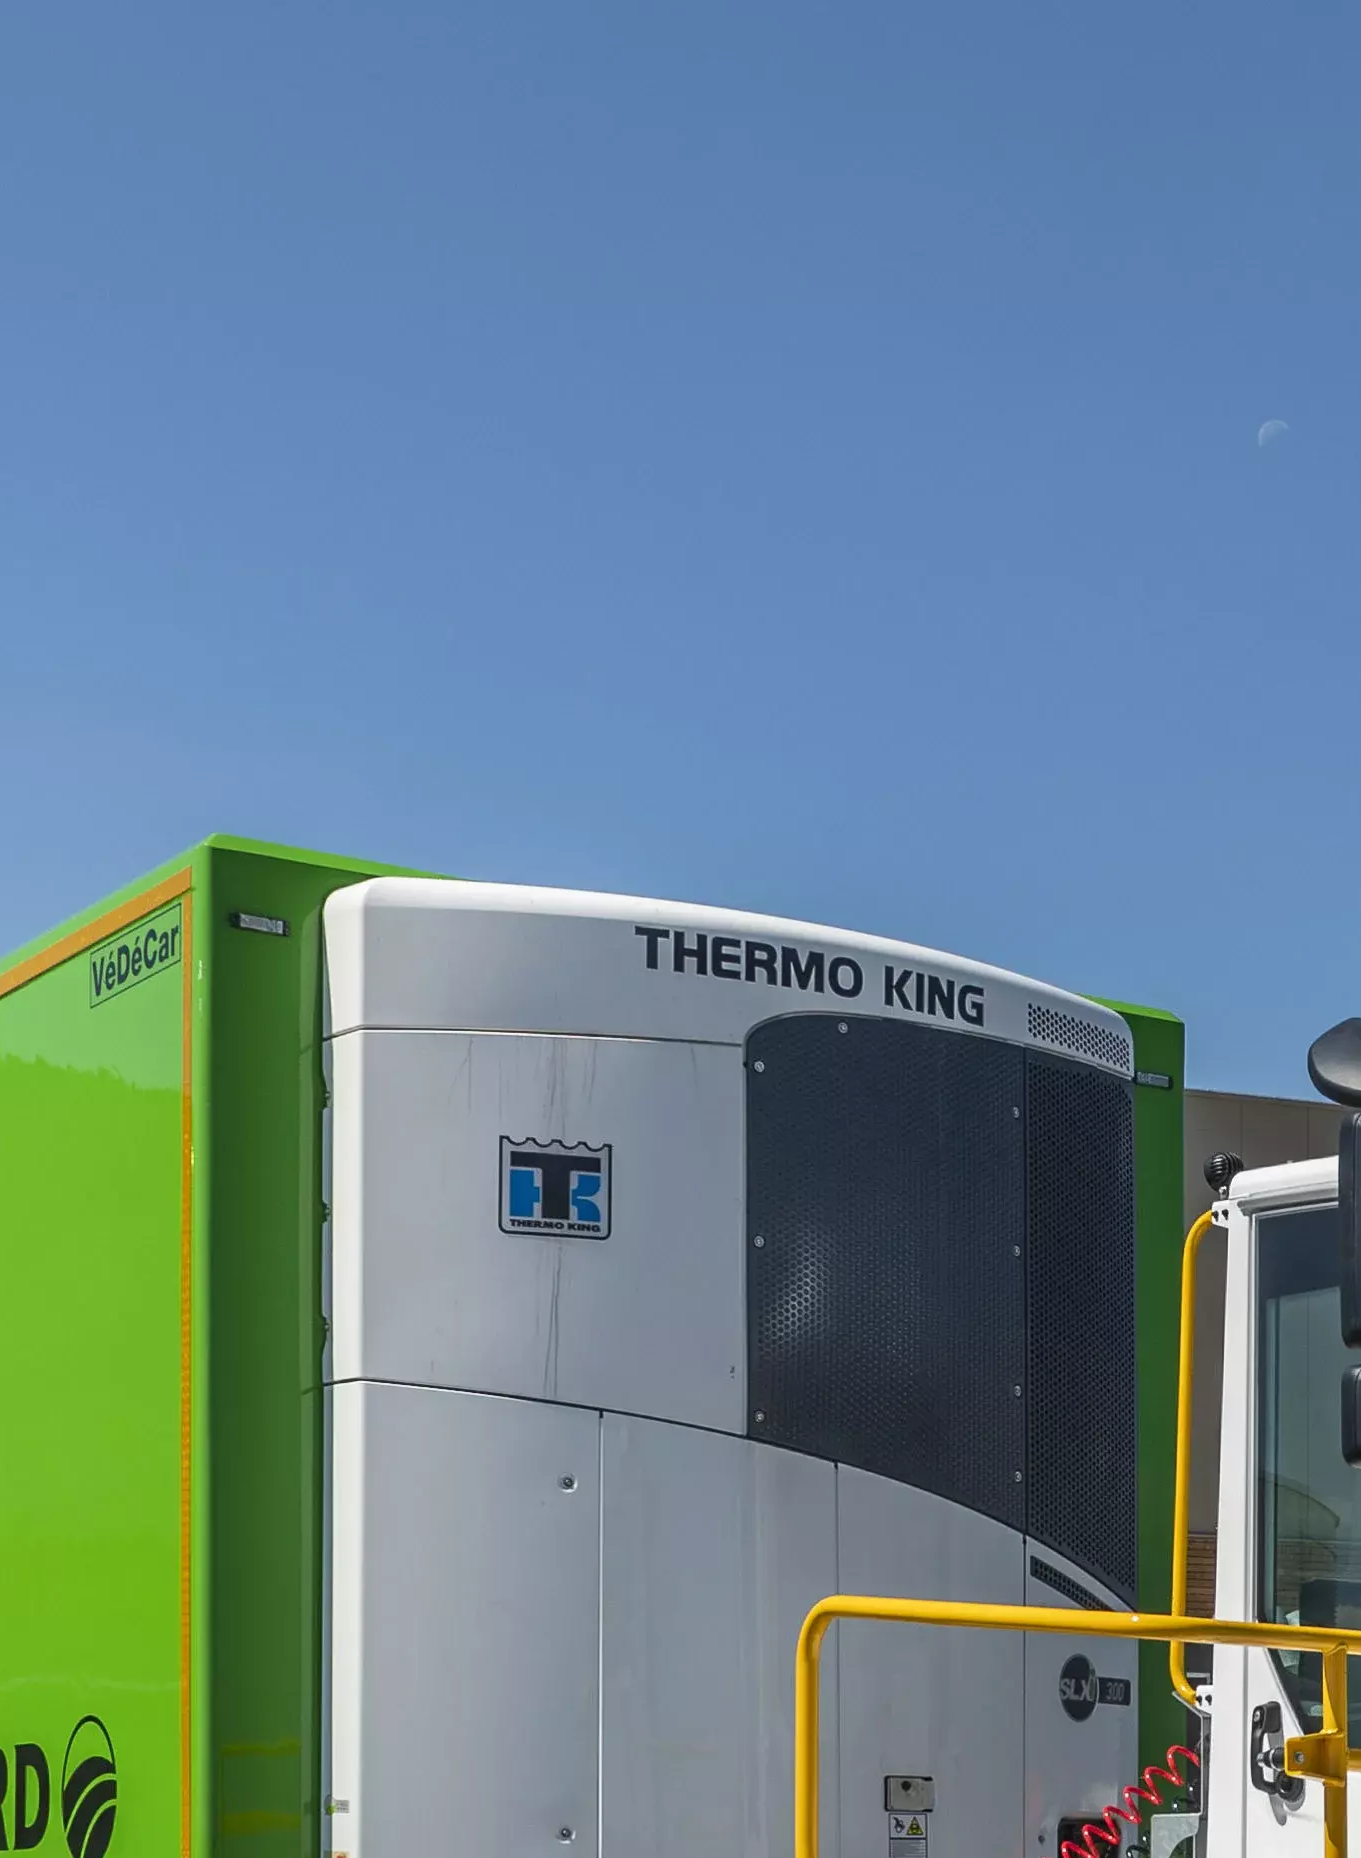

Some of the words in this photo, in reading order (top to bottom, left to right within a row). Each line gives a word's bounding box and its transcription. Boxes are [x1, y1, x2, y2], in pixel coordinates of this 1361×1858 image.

[92, 925, 179, 997] VéDéCar
[634, 925, 864, 998] THERMO
[884, 965, 985, 1027] KING
[509, 1219, 565, 1231] THERMO
[567, 1222, 601, 1233] KING
